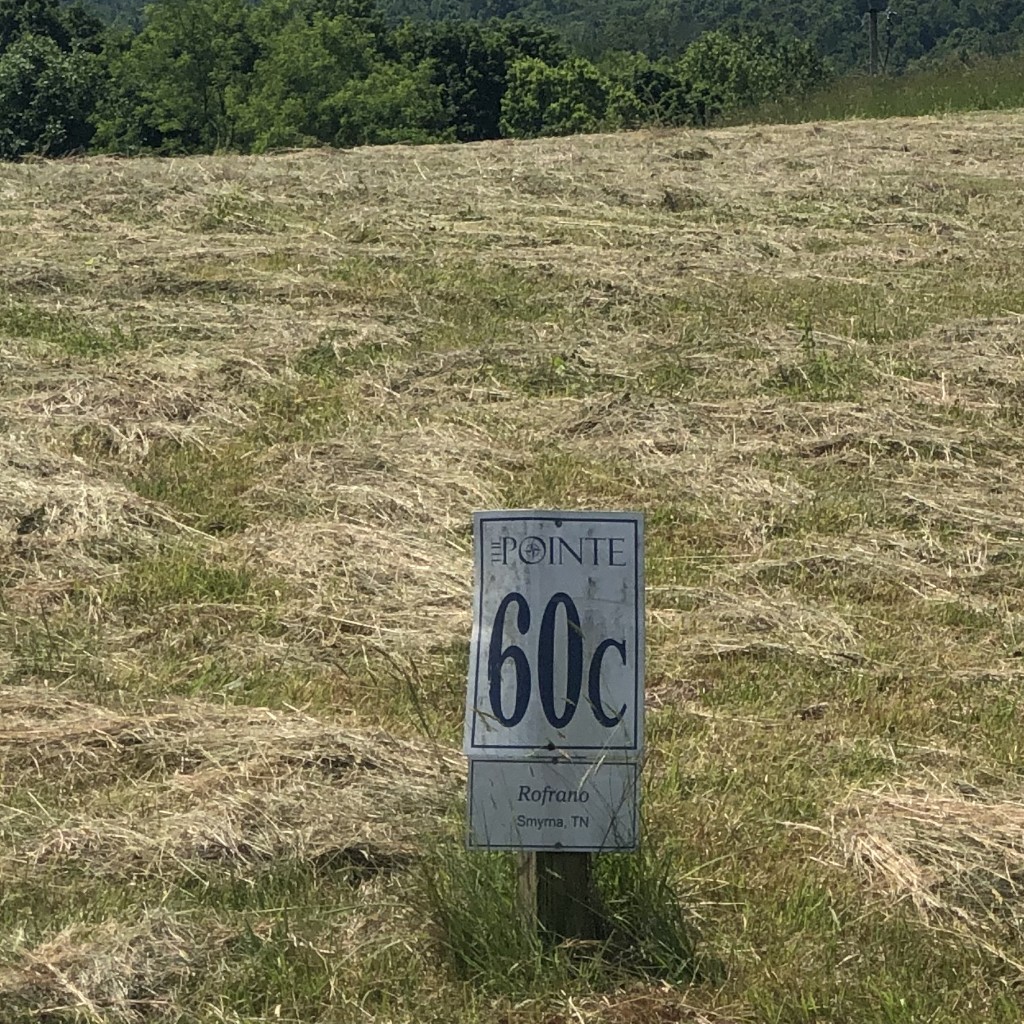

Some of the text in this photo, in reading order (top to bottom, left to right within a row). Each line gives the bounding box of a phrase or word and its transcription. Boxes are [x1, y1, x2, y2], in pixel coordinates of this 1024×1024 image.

[502, 536, 627, 566] POINTE
[517, 785, 590, 806] Rofrano
[517, 815, 589, 830] Smyrna, TN
